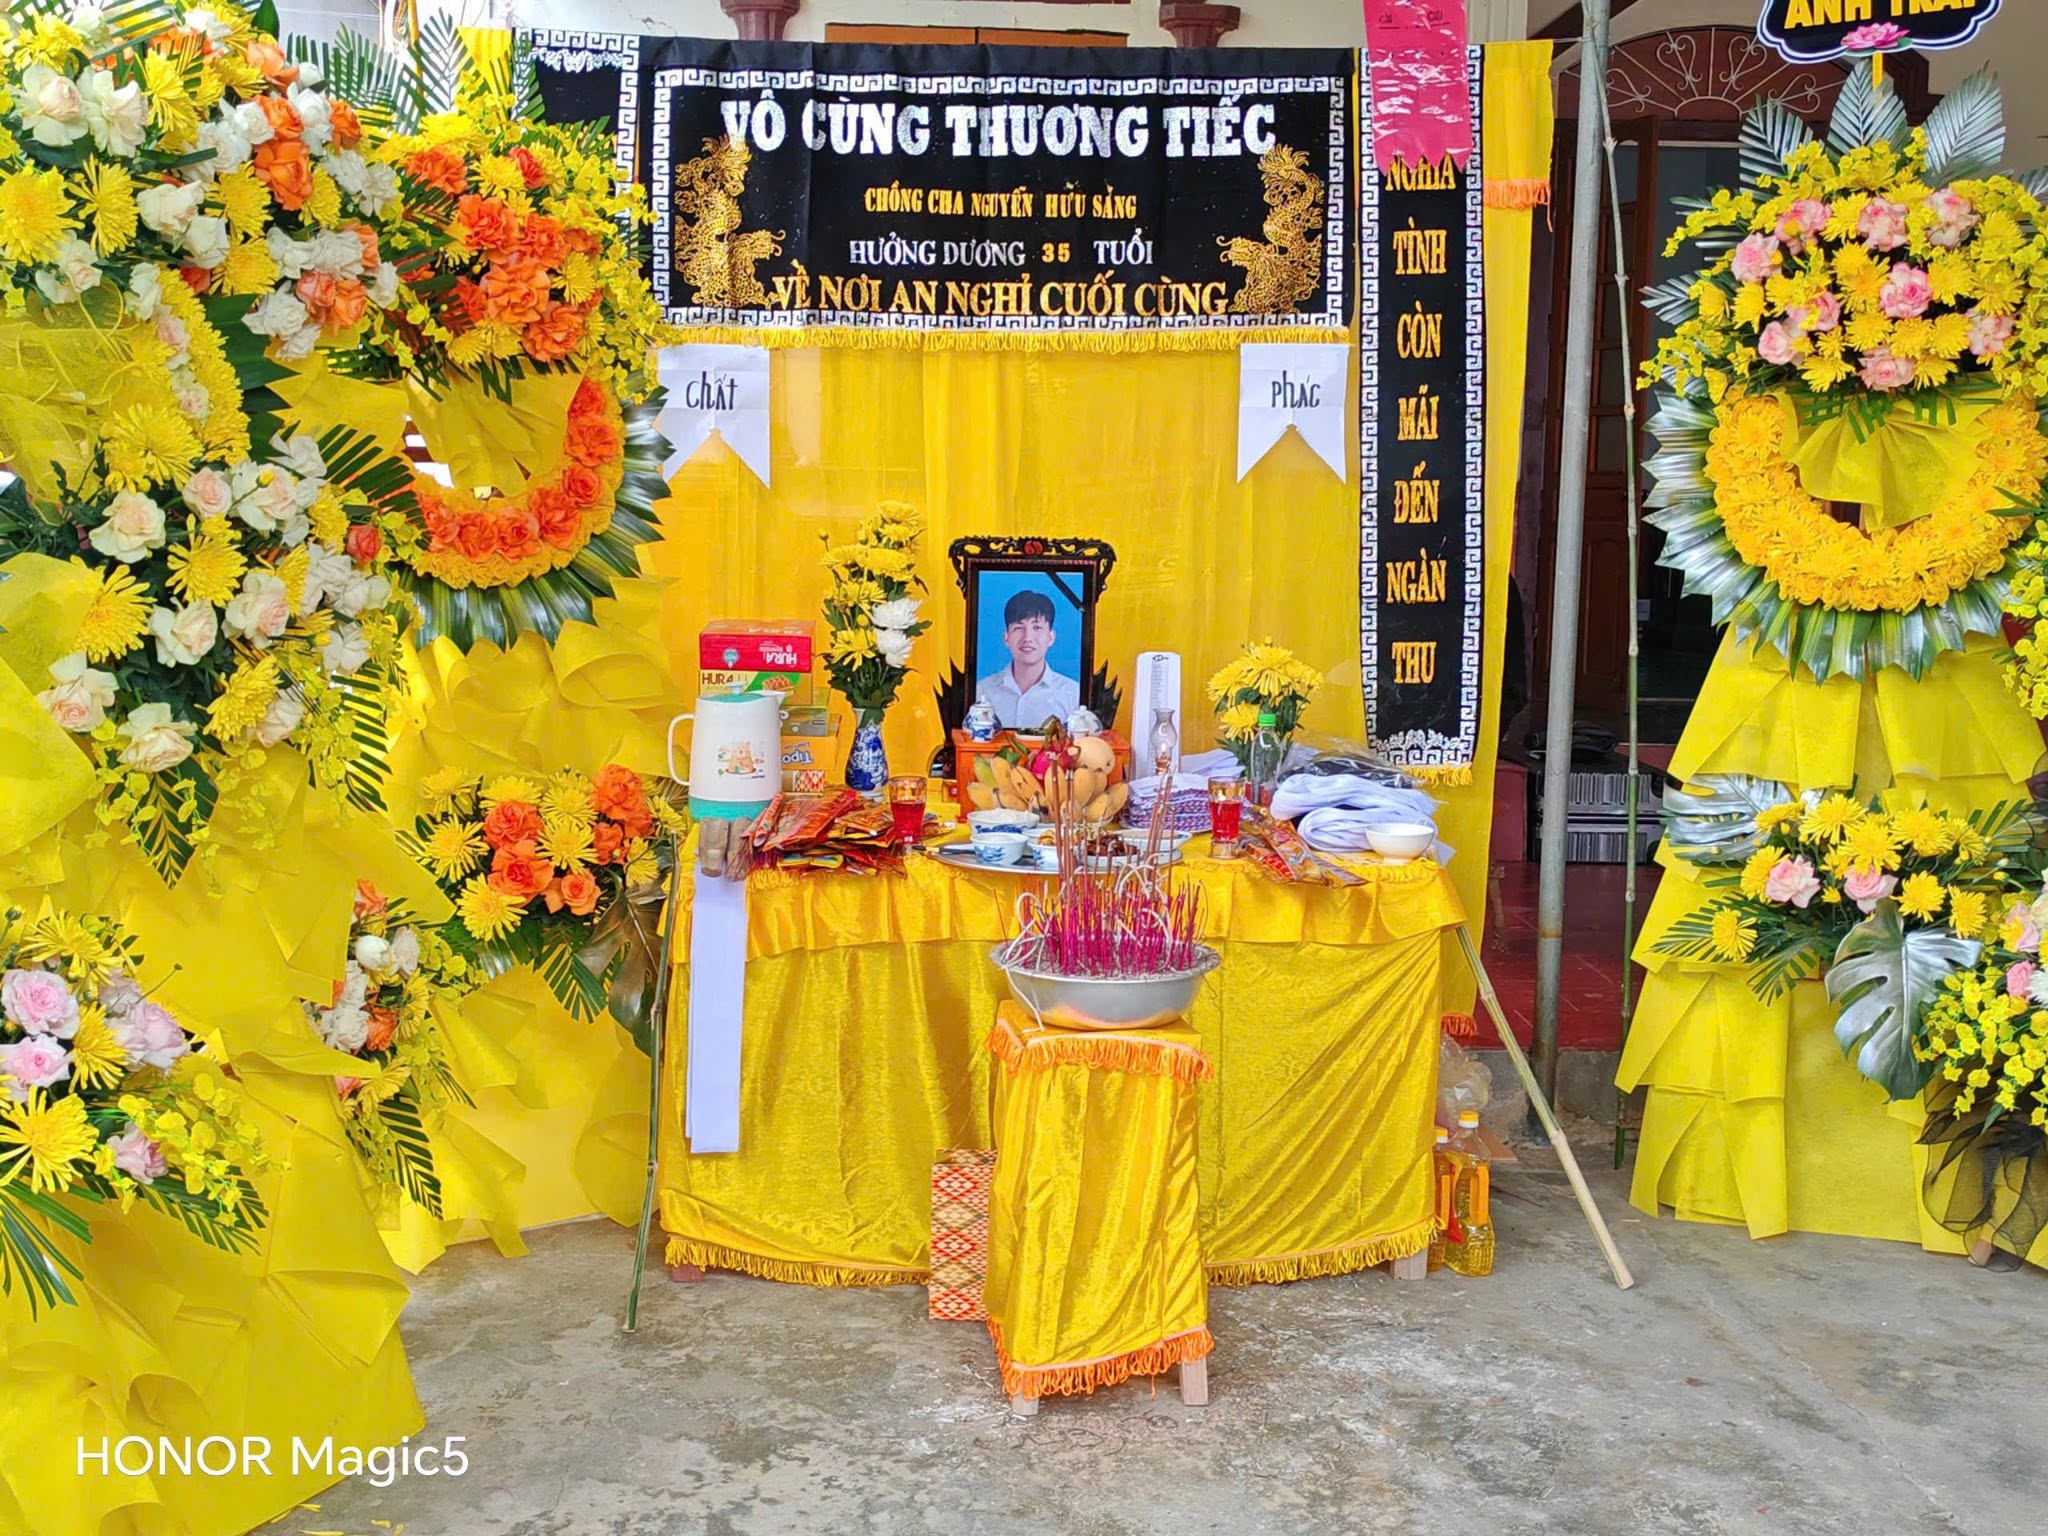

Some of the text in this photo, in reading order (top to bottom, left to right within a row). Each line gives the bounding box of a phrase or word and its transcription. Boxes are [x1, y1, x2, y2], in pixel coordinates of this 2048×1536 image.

[719, 89, 1276, 158] VÔ CÙNG THƯƠNG TIẾC
[927, 188, 965, 215] CHA
[970, 185, 1033, 218] NGUYỄN
[849, 228, 1153, 267] HƯỞNG DƯƠNG 35 TUỔI
[1392, 216, 1447, 275] TÌNH
[771, 258, 1229, 316] VỀ NƠI AN NGHỈ CUỐI CÙNG
[1396, 299, 1442, 359] CÒN
[1397, 384, 1440, 441] MÃI
[1393, 460, 1441, 524] ĐẾN
[1385, 547, 1447, 604] NGÀN
[765, 652, 798, 665] HURA
[1391, 641, 1437, 684] THU
